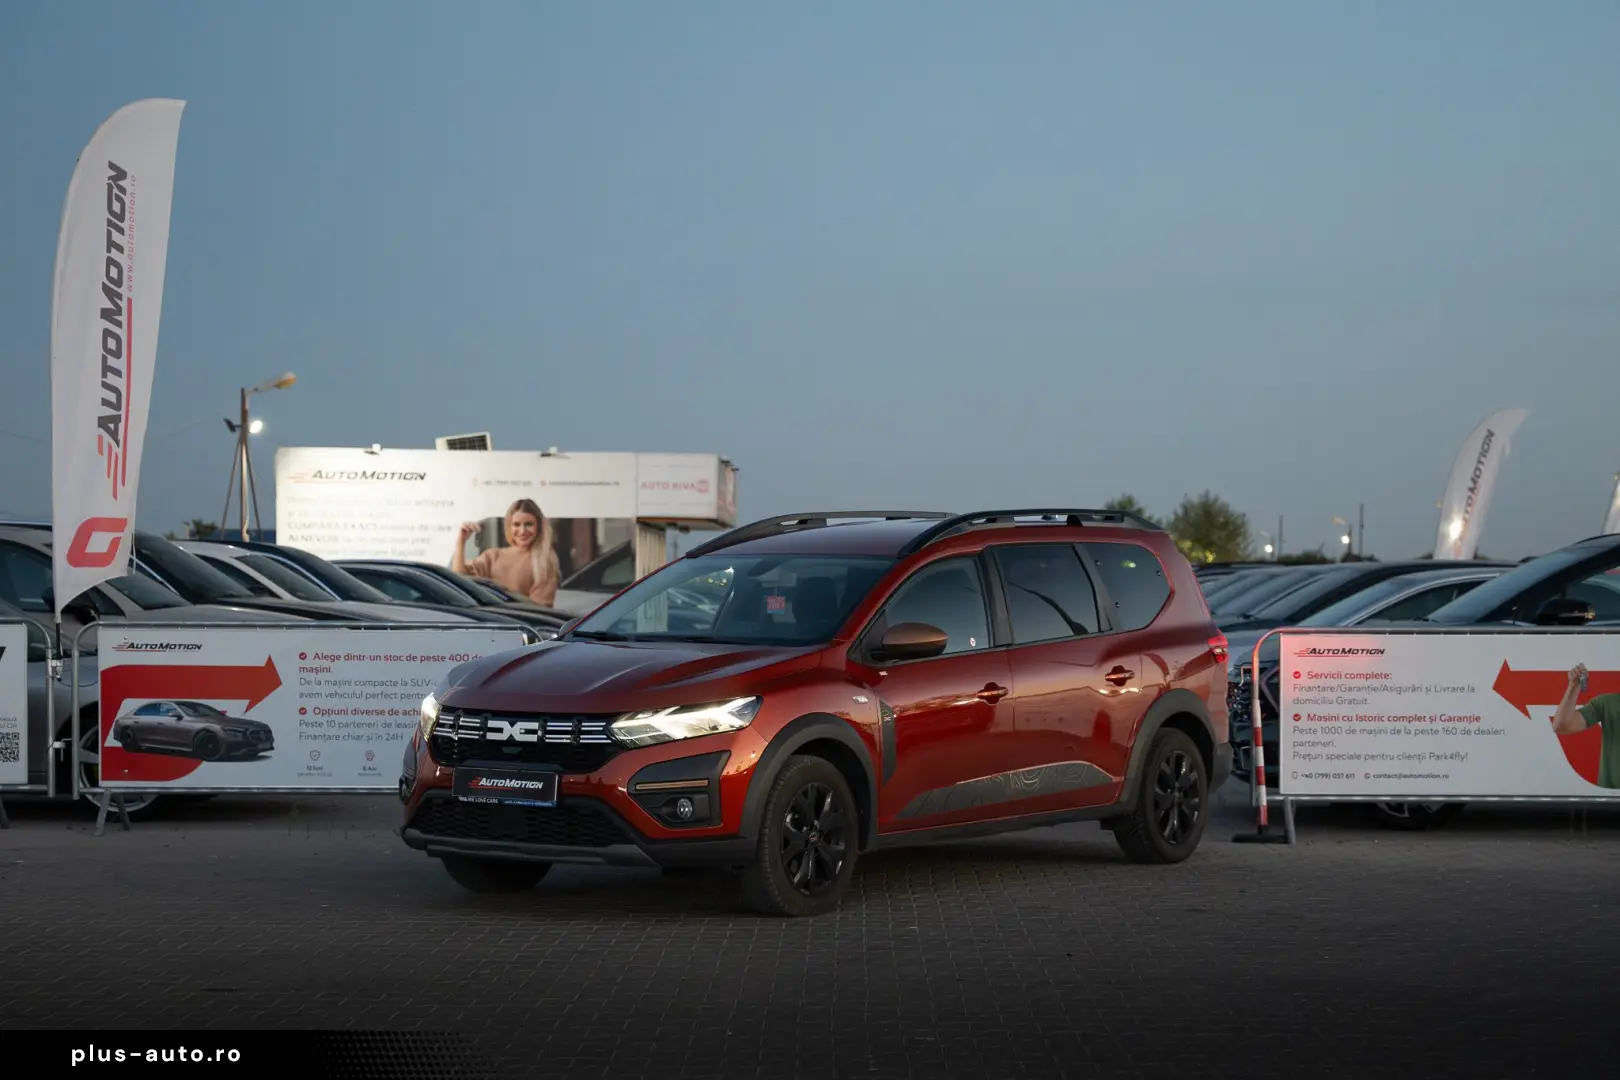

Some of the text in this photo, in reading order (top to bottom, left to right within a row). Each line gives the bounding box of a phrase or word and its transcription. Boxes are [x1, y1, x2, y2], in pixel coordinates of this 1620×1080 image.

[126, 175, 137, 292] www.automotion.ro
[313, 652, 341, 663] Alege
[343, 652, 381, 662] dintr-un
[384, 653, 404, 662] stoc
[405, 653, 418, 662] de
[420, 654, 446, 664] peste
[449, 653, 470, 662] 400
[1307, 671, 1393, 682] Servicii complete:
[299, 677, 312, 686] De
[315, 677, 322, 686] la
[354, 679, 399, 688] compacte
[400, 677, 409, 687] la
[1434, 684, 1465, 693] Livrare
[1467, 684, 1476, 693] la
[298, 691, 323, 699] avem
[325, 690, 363, 699] vehiculul
[365, 690, 398, 701] perfect
[1292, 696, 1334, 705] domiciliu
[350, 707, 386, 716] diverse
[387, 707, 400, 716] de
[1341, 714, 1353, 722] cu
[1355, 713, 1385, 722] Istoric
[1387, 713, 1427, 724] complet
[299, 719, 324, 728] Peste
[326, 720, 336, 728] 10
[338, 720, 379, 730] parteneri
[381, 720, 393, 729] de
[342, 732, 364, 741] chiar
[385, 733, 404, 741] 24H
[1293, 726, 1318, 735] Peste
[1320, 726, 1342, 735] 1000
[1345, 726, 1357, 735] de
[1390, 726, 1402, 735] de
[1404, 726, 1412, 735] la
[1414, 727, 1440, 737] peste
[1442, 727, 1457, 736] 160
[1460, 726, 1472, 736] de
[1473, 727, 1506, 736] dealeri
[1325, 752, 1362, 762] speciale
[1364, 753, 1395, 762] pentru
